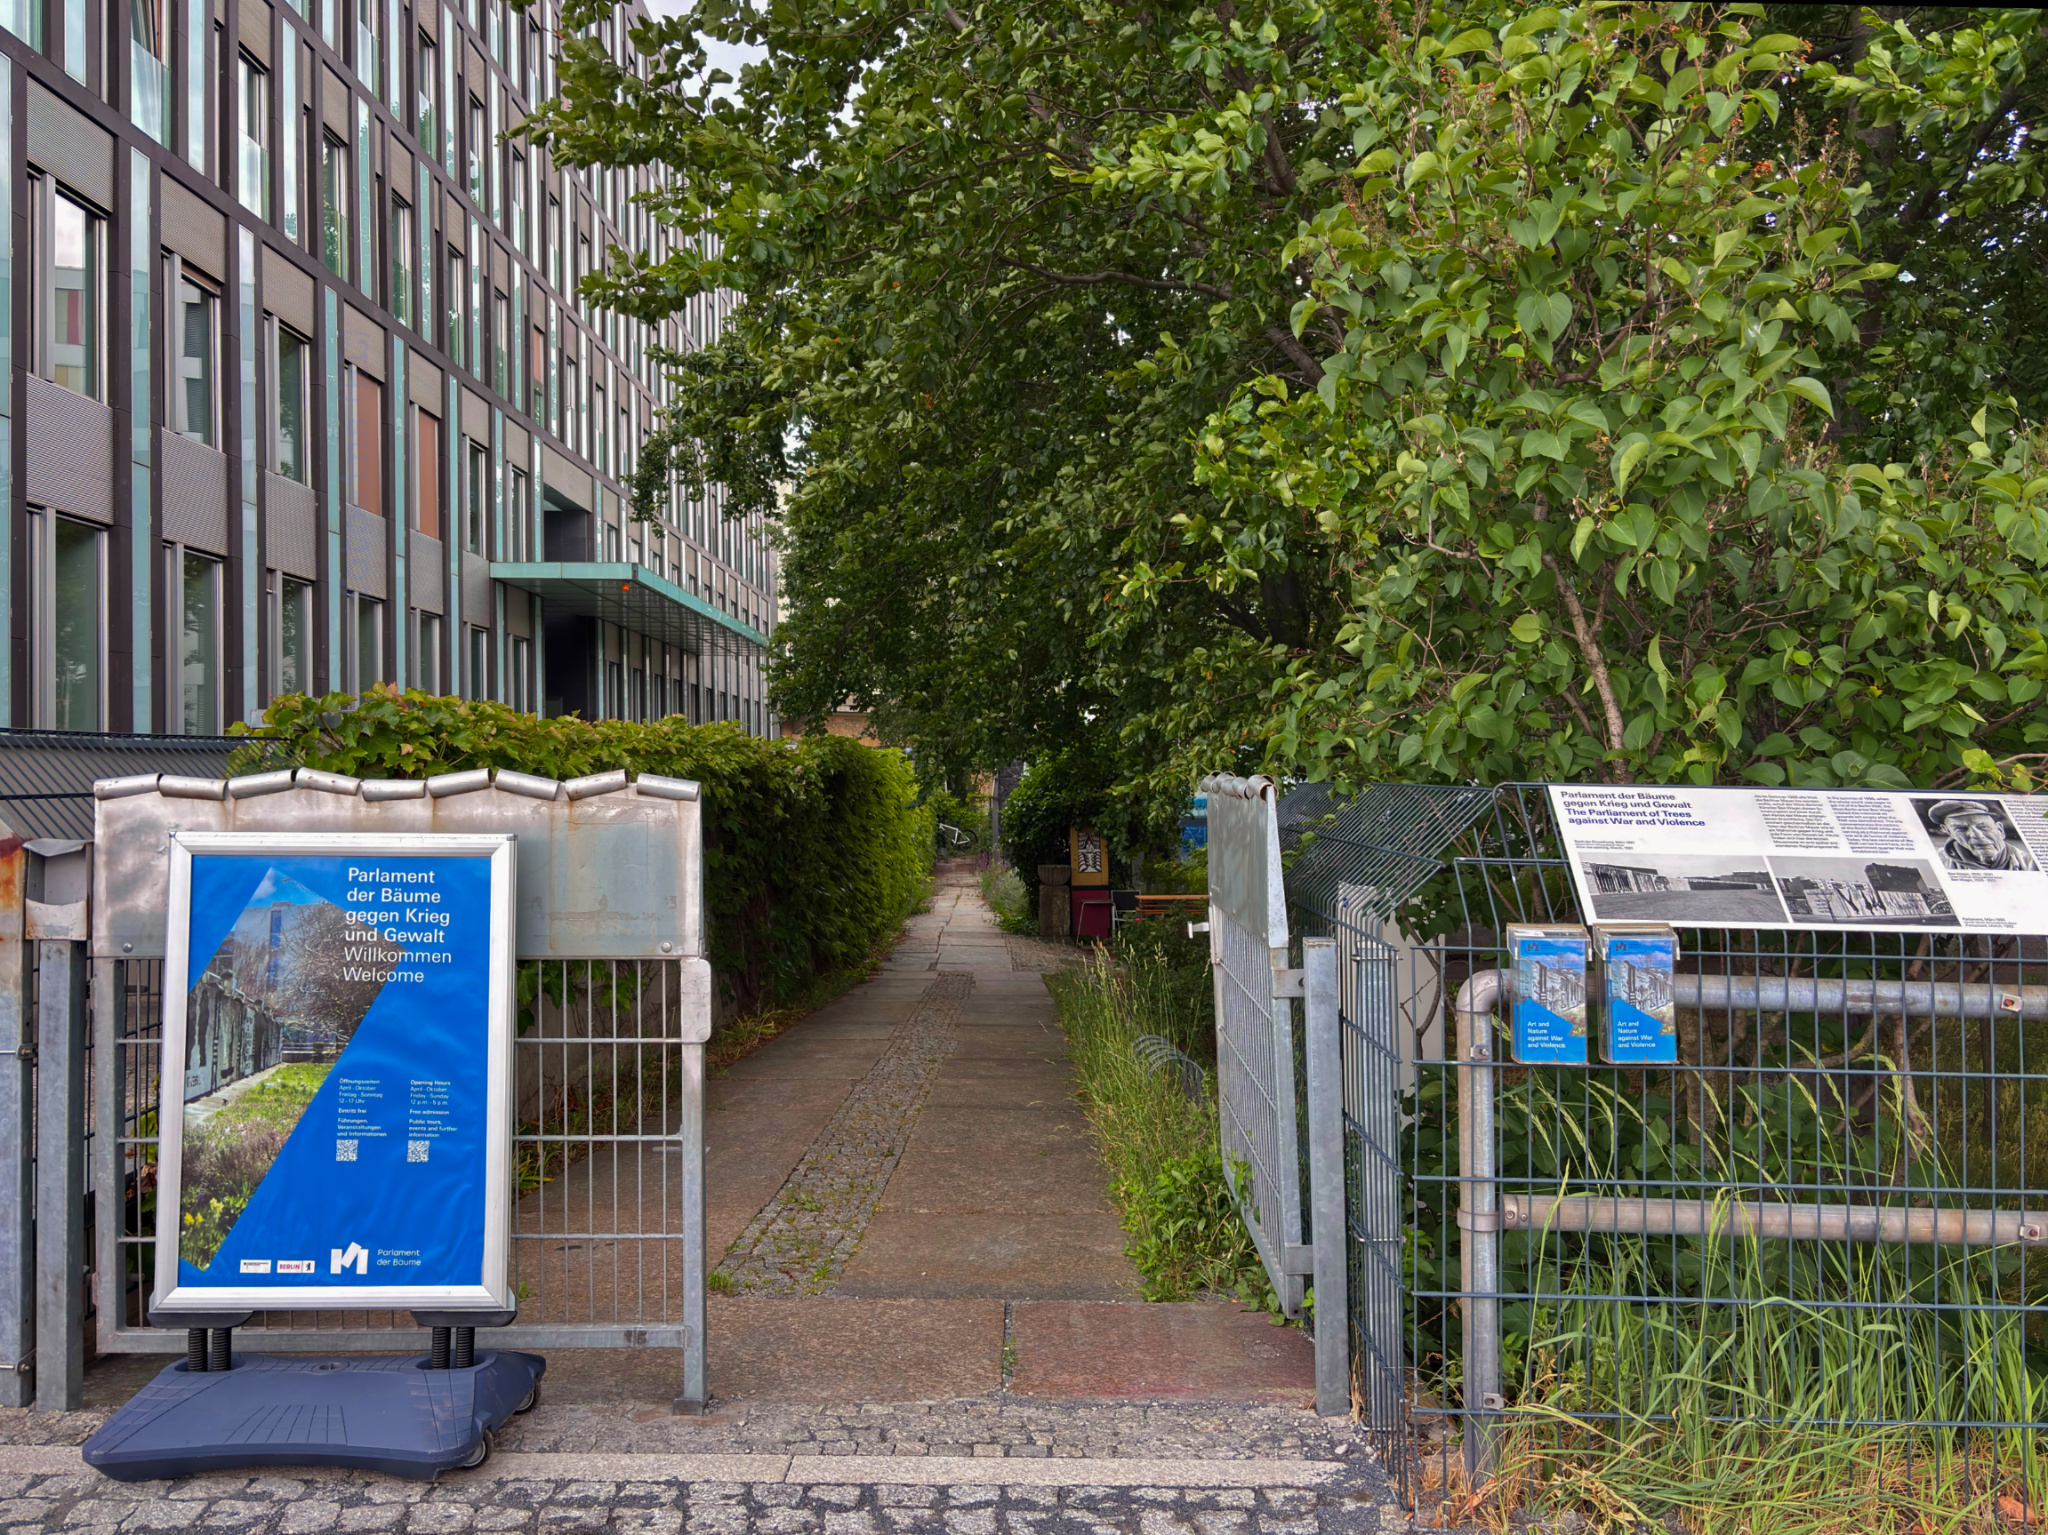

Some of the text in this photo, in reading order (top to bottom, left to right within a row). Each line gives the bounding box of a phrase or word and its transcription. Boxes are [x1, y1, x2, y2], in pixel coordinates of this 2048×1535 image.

[1599, 800, 1628, 808] Krieg
[1588, 809, 1647, 817] Parliament
[1568, 817, 1609, 825] against
[348, 867, 435, 884] Parlament
[347, 887, 441, 904] der Bäume
[345, 909, 450, 927] gegen Krieg
[345, 928, 445, 943] und Gewalt
[344, 947, 452, 963] Willkommen
[343, 967, 425, 982] Welcome
